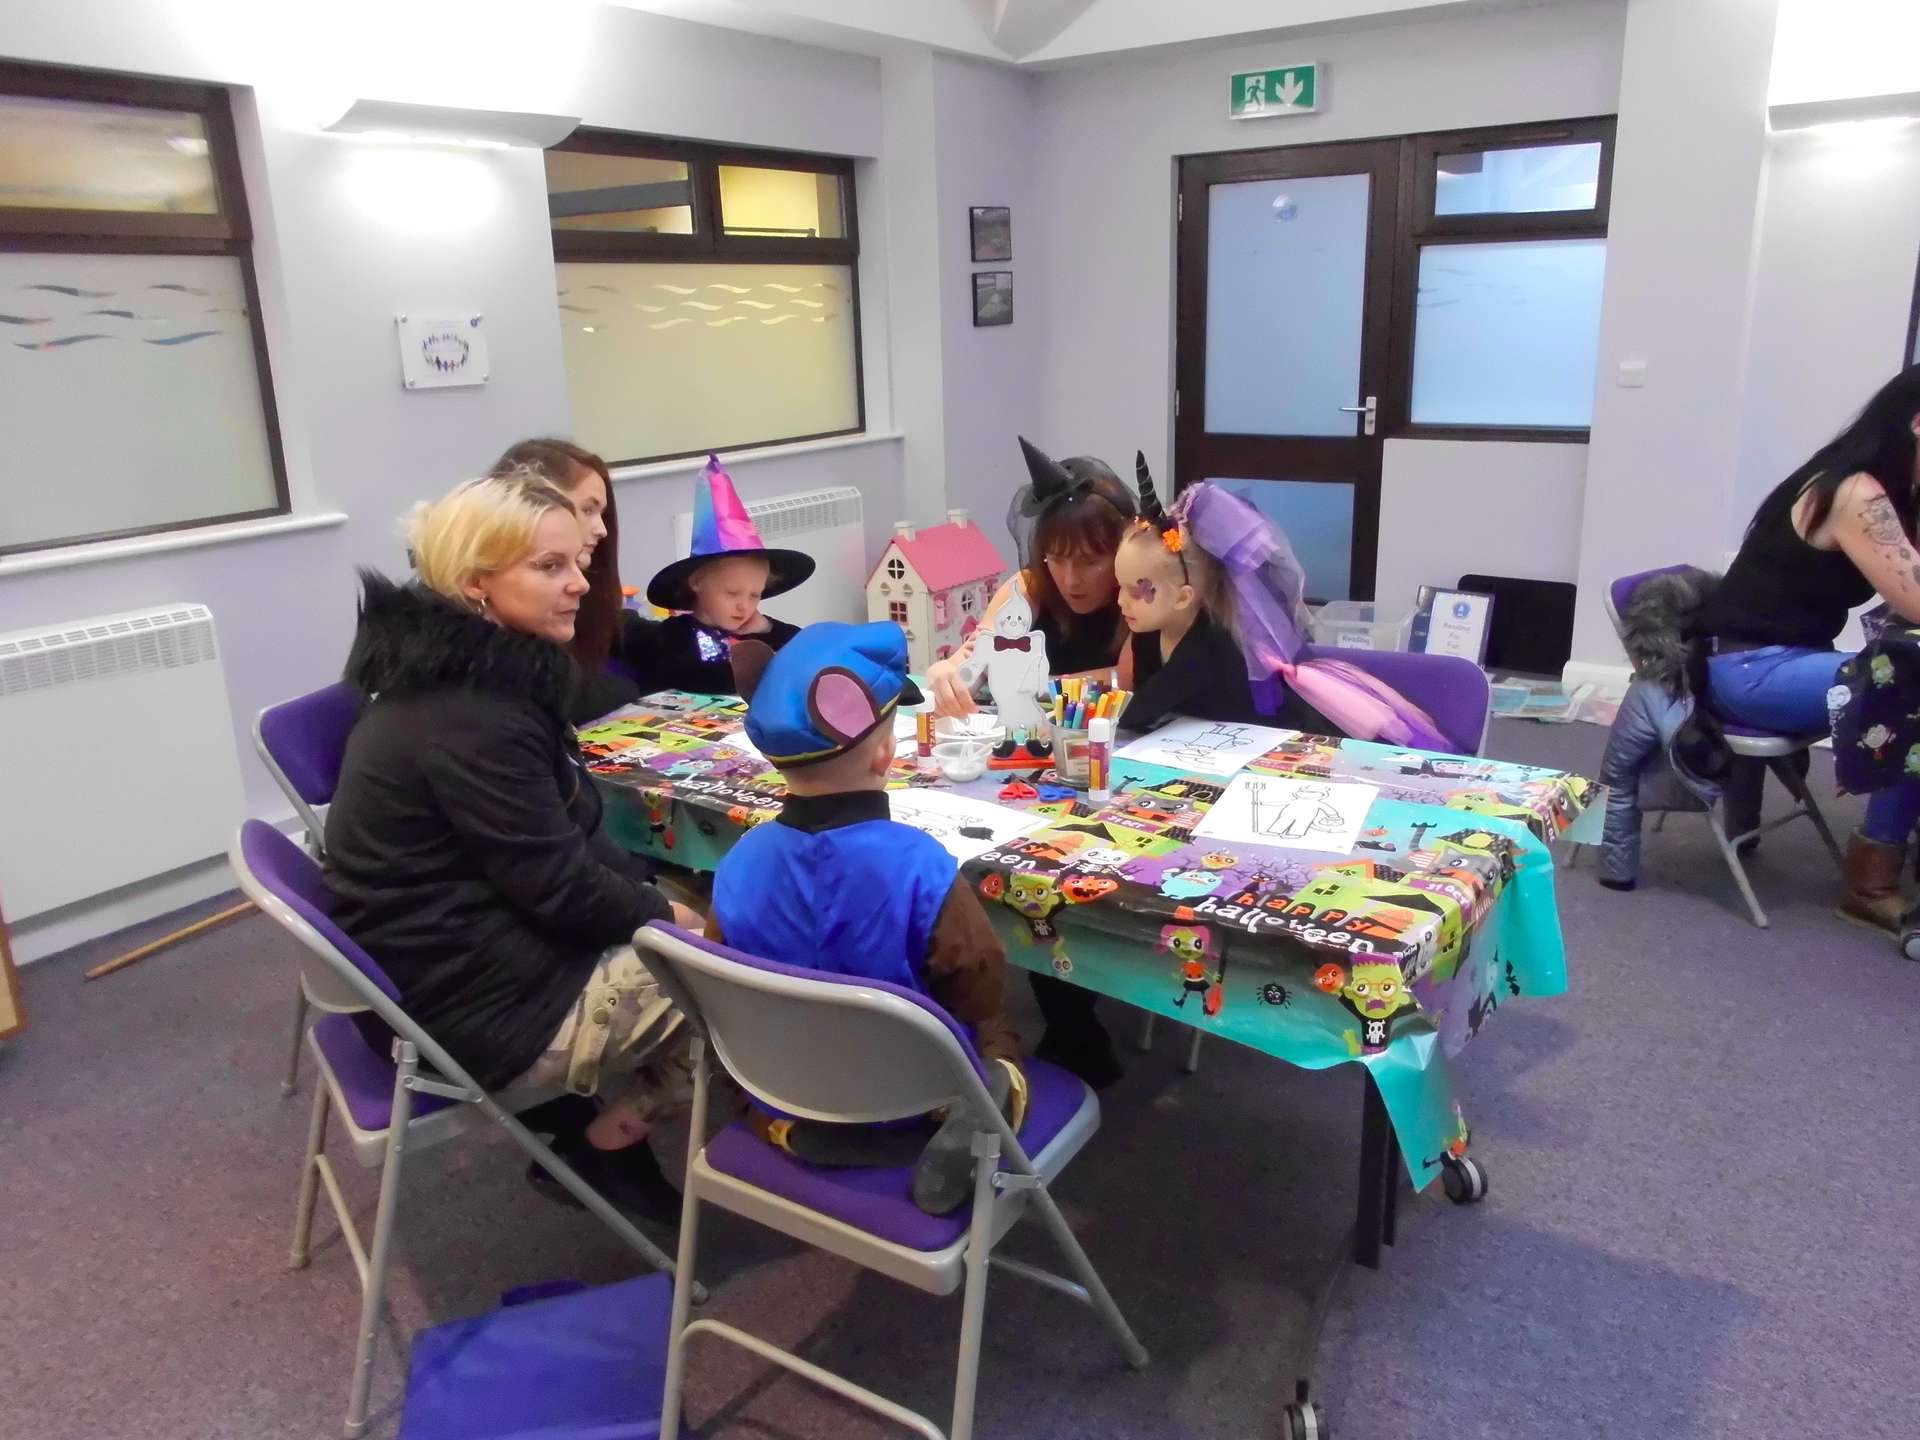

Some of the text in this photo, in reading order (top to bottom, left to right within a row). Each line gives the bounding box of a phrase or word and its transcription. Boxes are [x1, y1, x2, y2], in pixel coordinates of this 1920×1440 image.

[672, 773, 784, 809] halloween
[1193, 896, 1375, 954] halloween
[1235, 892, 1373, 932] happy
